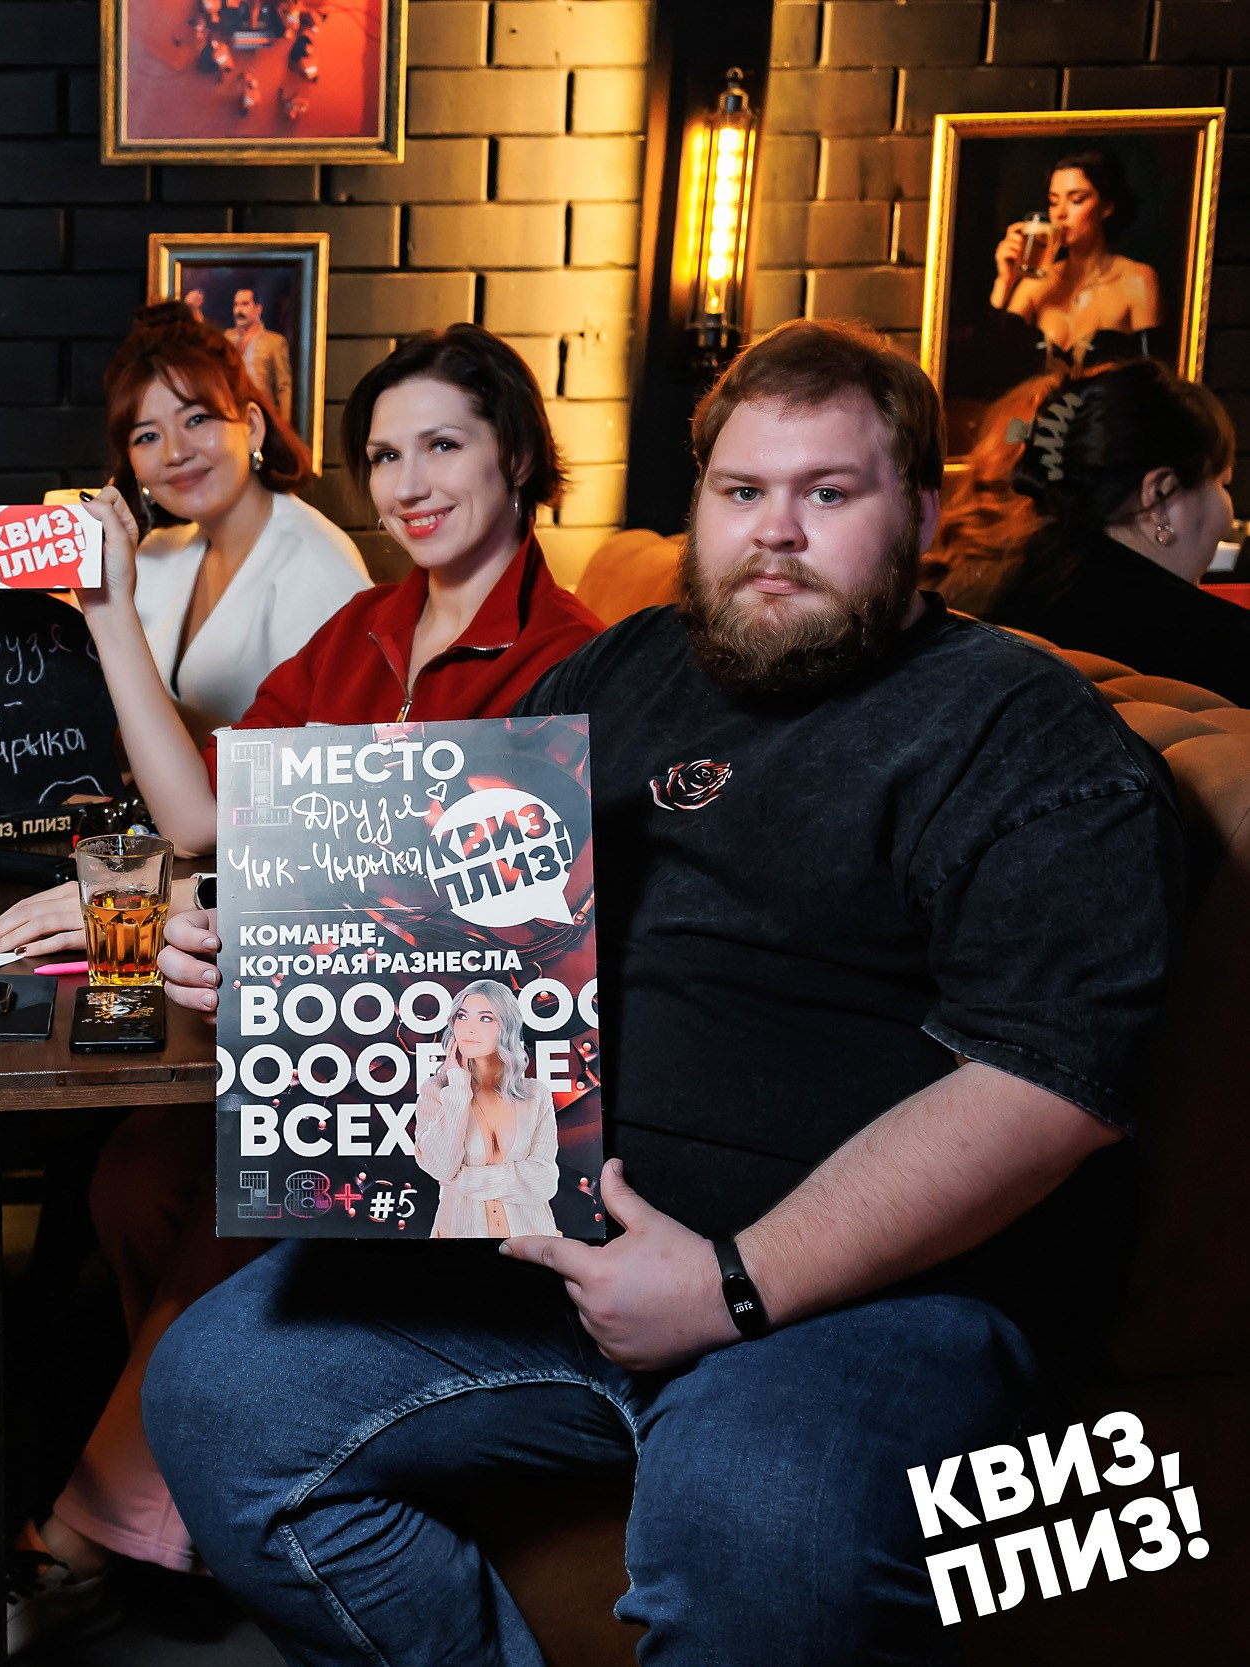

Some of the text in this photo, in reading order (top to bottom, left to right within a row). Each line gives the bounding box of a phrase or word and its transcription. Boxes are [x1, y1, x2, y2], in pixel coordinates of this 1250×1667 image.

[281, 740, 465, 786] МЕСТО
[22, 816, 72, 834] ПЛИЗ!
[427, 803, 566, 870] КВИЗ,
[434, 838, 572, 908] ПЛИЗ!
[240, 923, 385, 949] КОМАНДЕ,
[240, 949, 523, 977] КОТОРАЯ РАЗНЕСЛА
[240, 1103, 418, 1157] ВСЕХ
[237, 1170, 364, 1219] 18+
